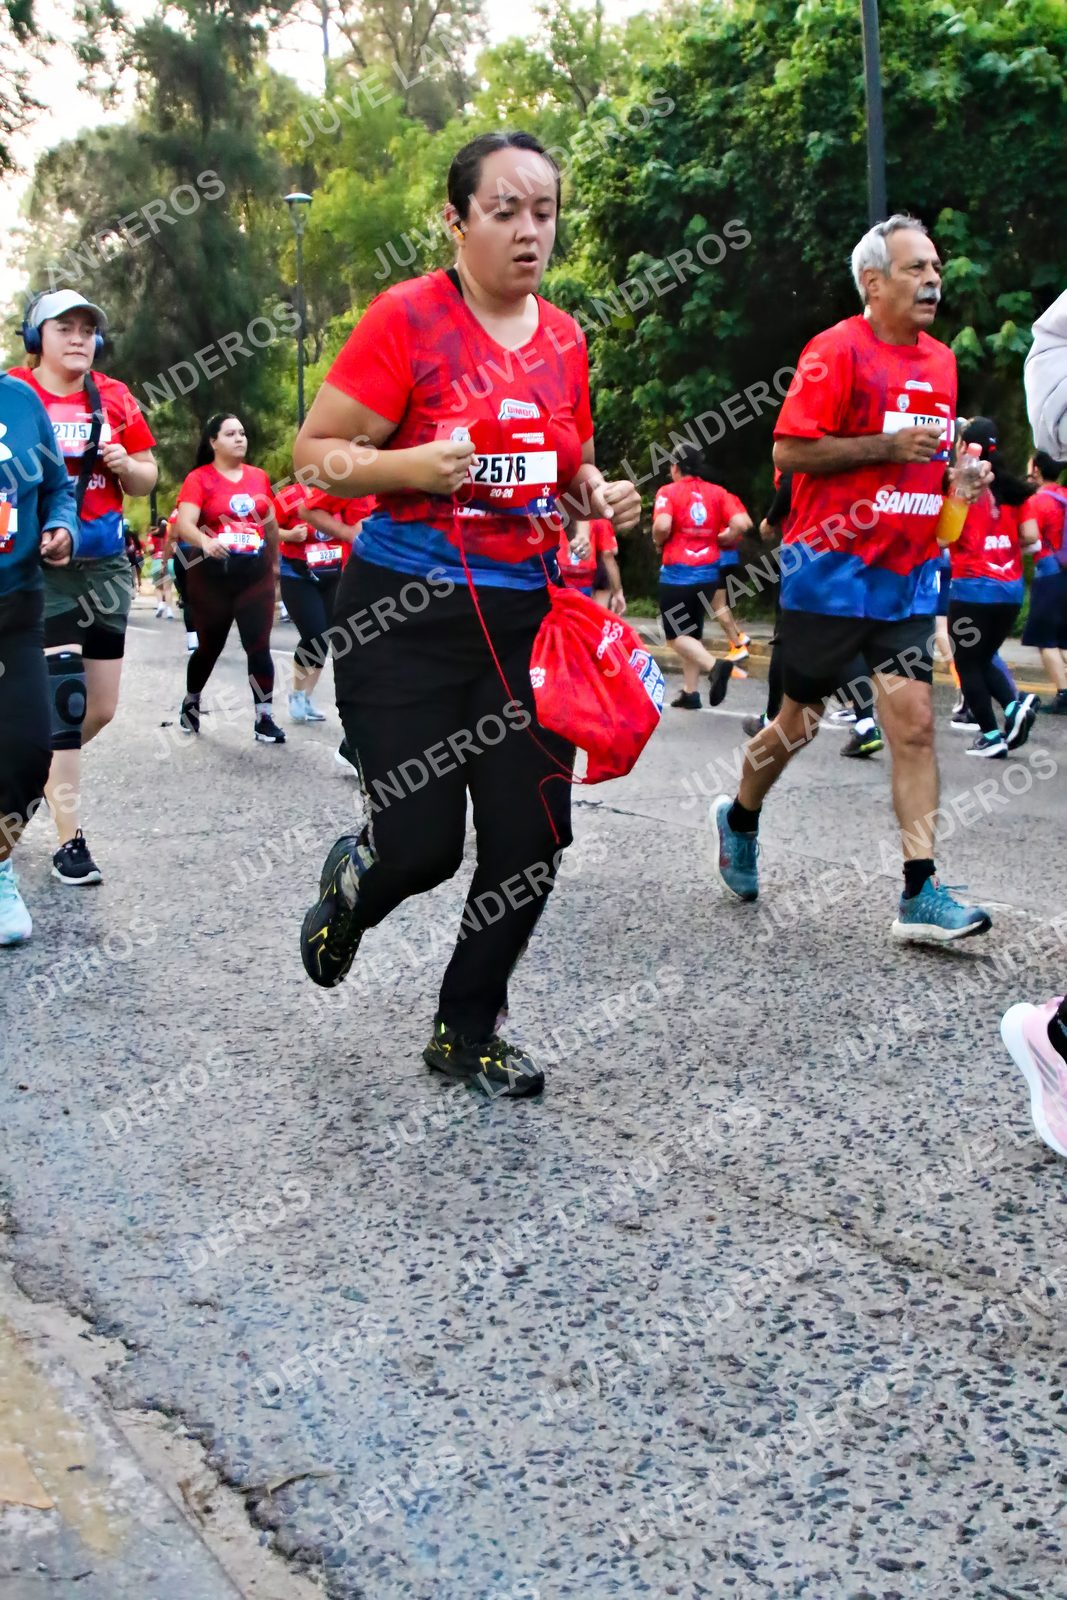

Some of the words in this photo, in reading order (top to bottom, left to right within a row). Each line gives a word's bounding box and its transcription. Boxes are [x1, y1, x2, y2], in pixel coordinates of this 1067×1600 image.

[53, 423, 87, 438] 2775
[474, 455, 526, 483] 2576
[872, 489, 943, 516] SANTIAG
